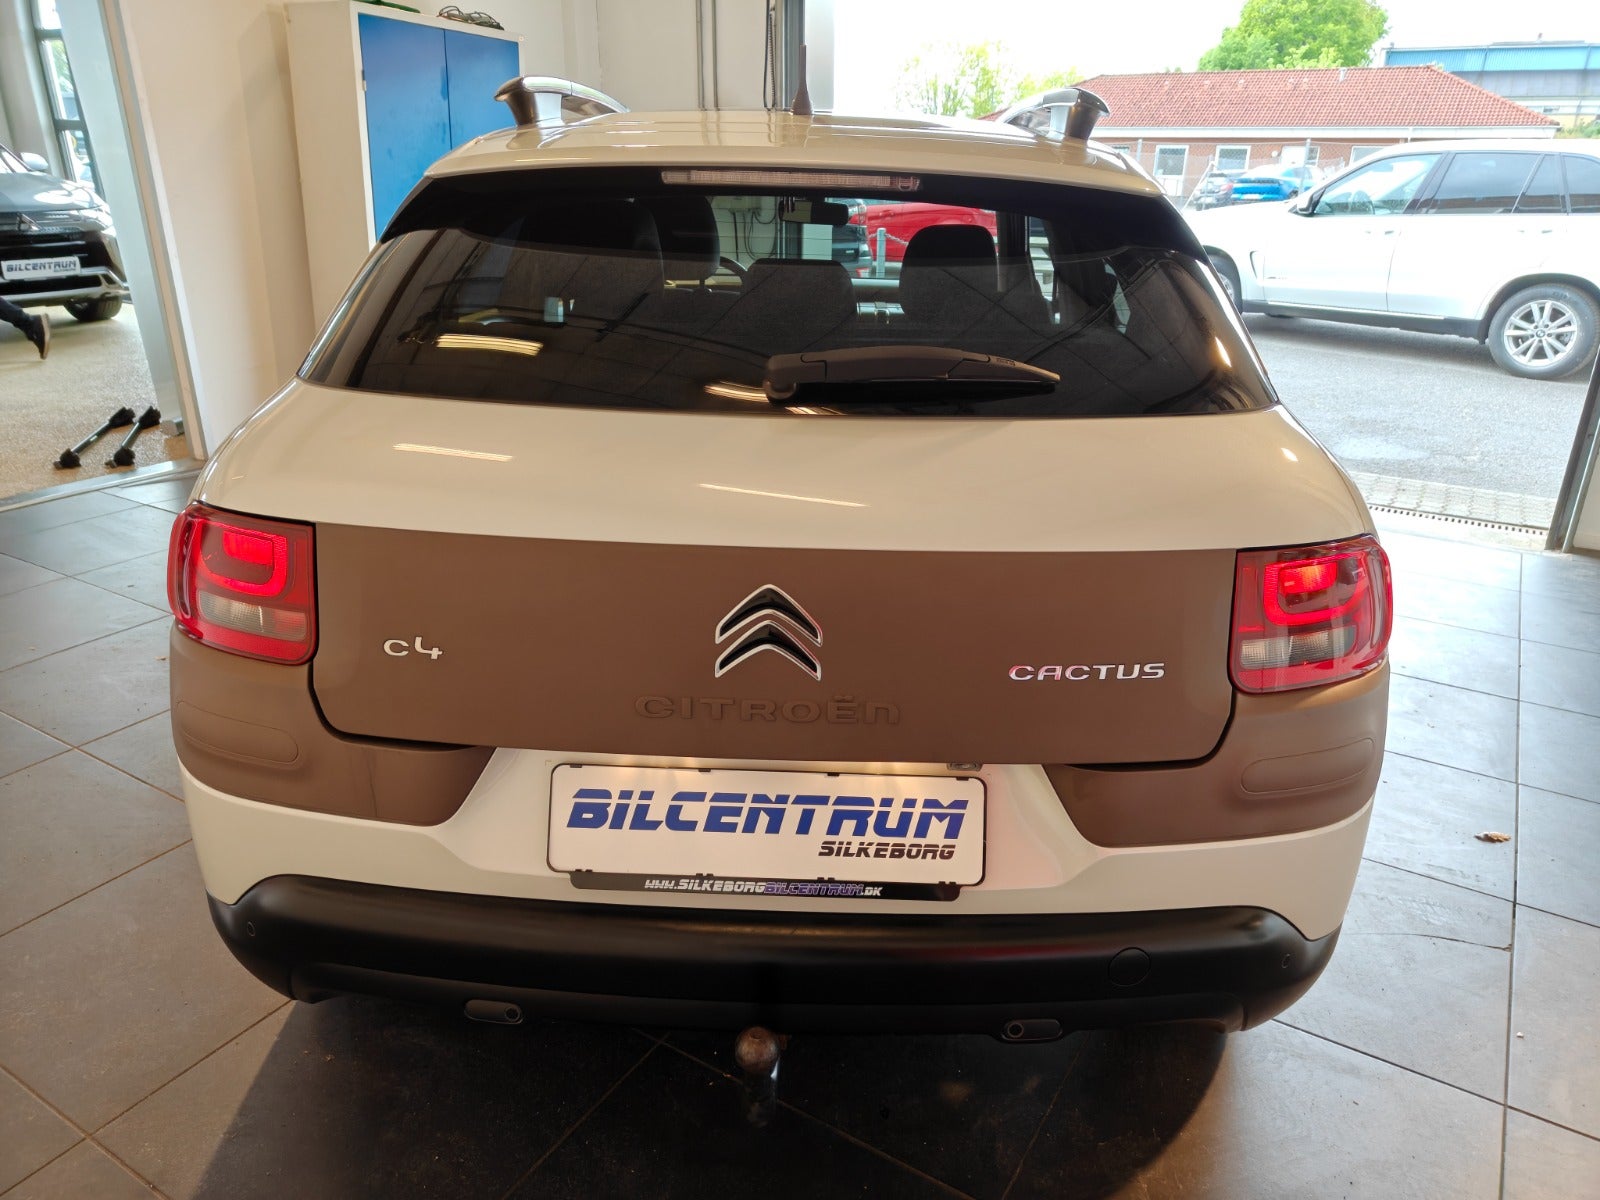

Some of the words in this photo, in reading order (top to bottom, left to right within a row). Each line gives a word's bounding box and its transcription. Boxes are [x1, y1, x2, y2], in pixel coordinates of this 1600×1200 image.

[6, 260, 77, 272] BILCENTRUM
[383, 636, 443, 660] C4
[1008, 662, 1165, 681] CACTUS
[566, 787, 969, 840] BILCENTRUM
[818, 840, 957, 860] SILKEBORG
[644, 878, 883, 897] WWW.SILKEBORGBILCENTRUM.DK
